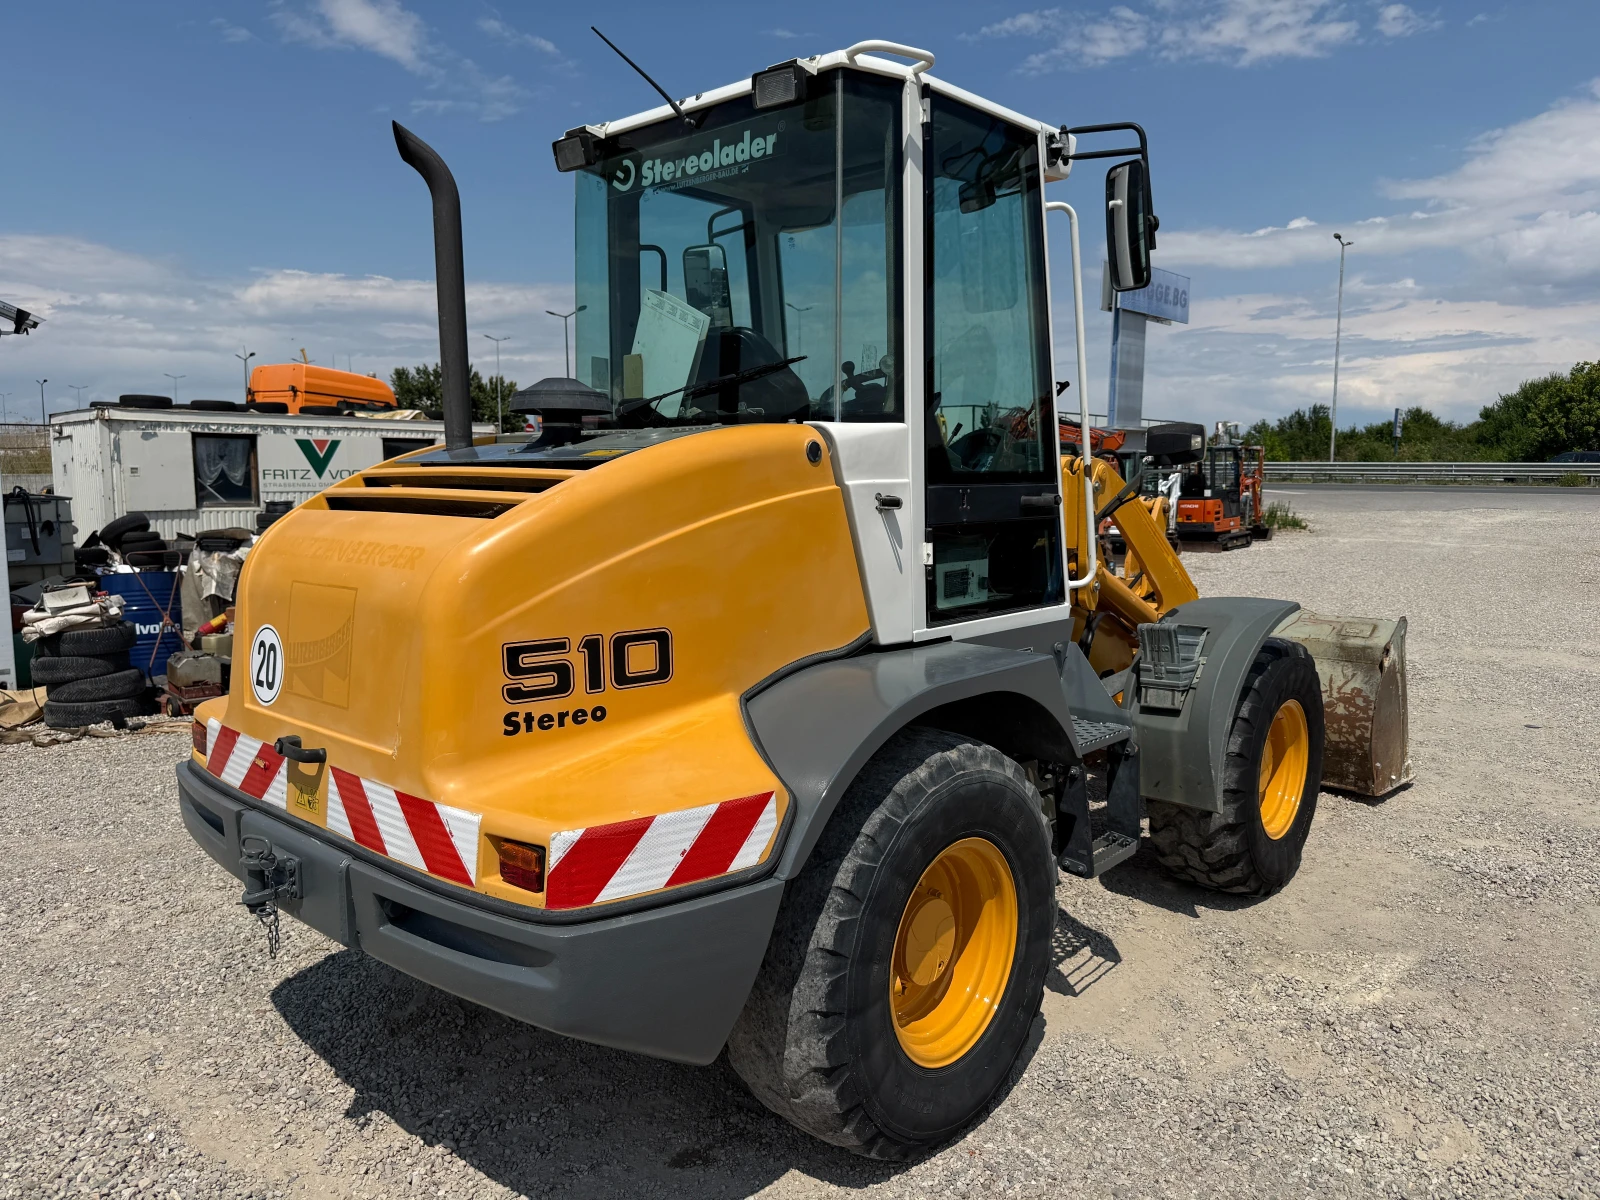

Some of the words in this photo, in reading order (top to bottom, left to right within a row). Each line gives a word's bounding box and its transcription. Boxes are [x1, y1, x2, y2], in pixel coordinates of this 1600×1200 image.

[641, 130, 777, 187] Stereolader
[262, 469, 311, 480] FRITZ
[255, 639, 277, 691] 20
[502, 627, 674, 705] 510
[503, 705, 607, 737] Stereo
